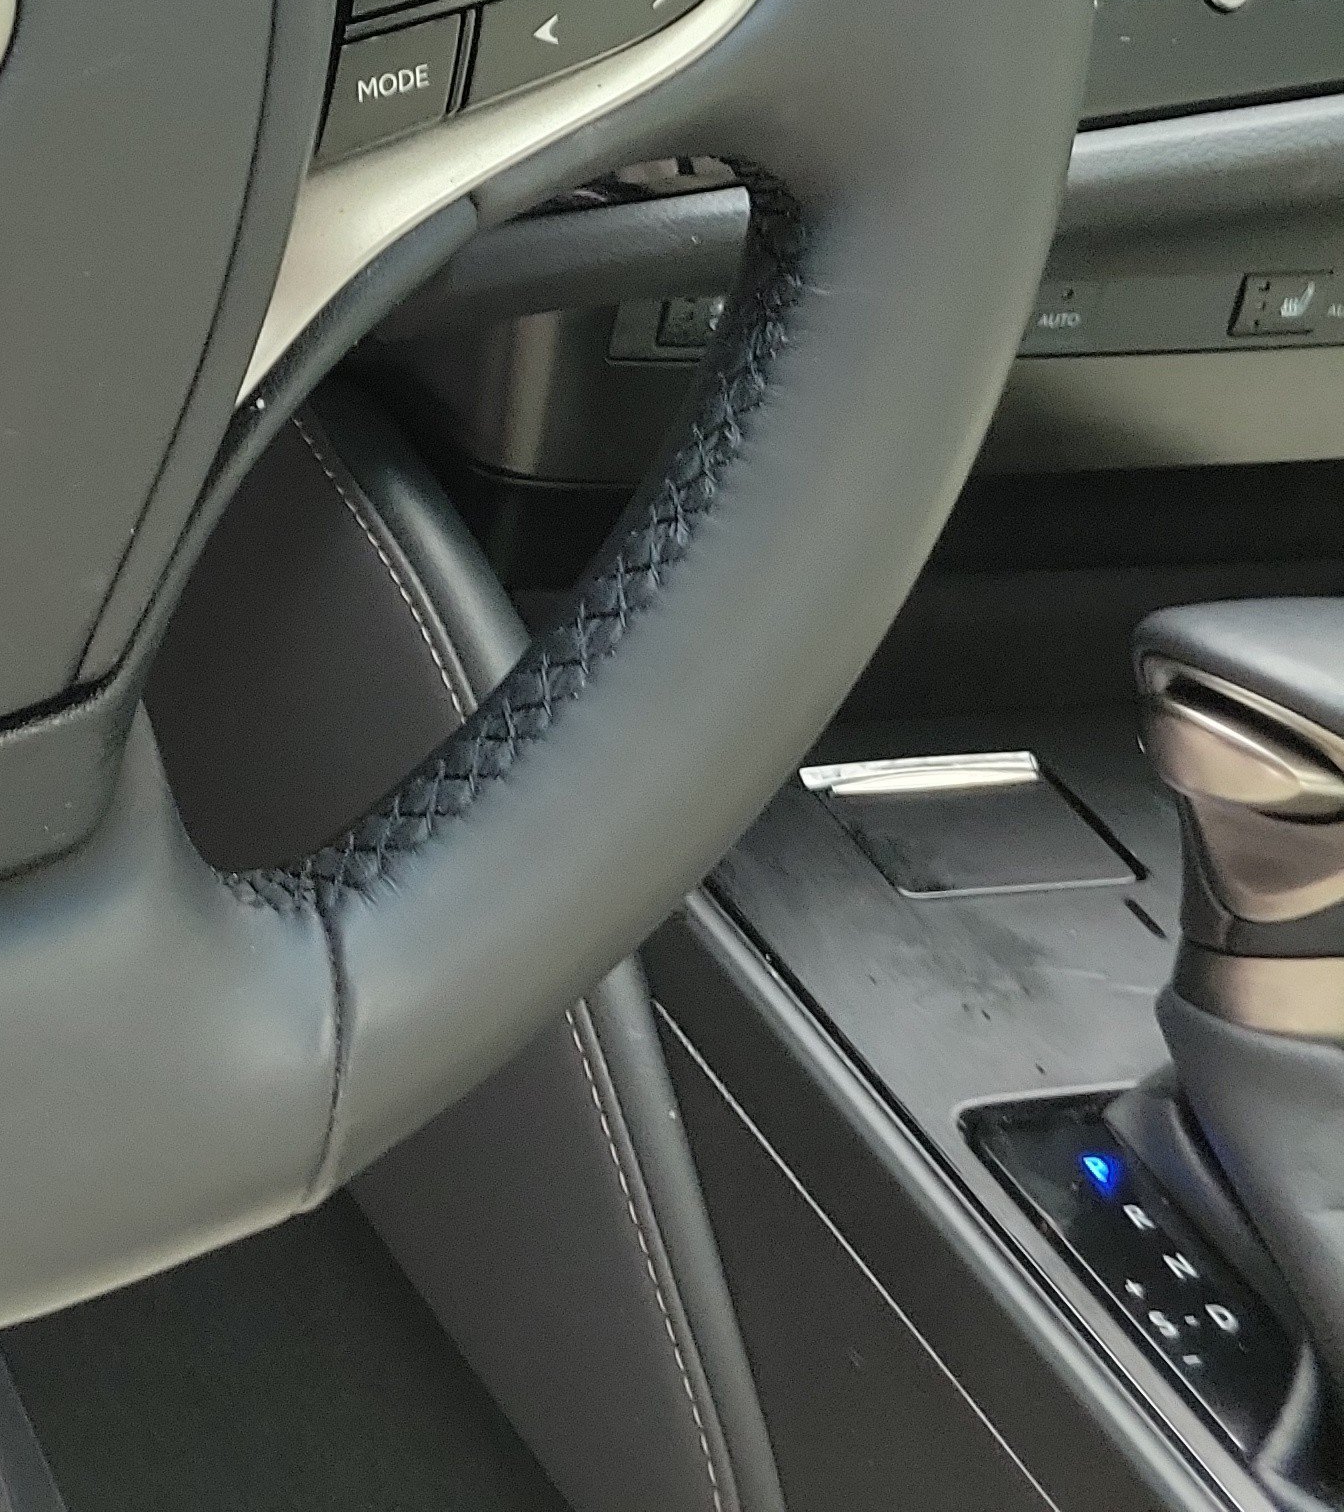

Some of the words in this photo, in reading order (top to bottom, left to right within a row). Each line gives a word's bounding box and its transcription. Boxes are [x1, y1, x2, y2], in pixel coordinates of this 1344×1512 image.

[356, 63, 431, 104] MODE
[1037, 311, 1083, 329] AUTO
[1123, 1203, 1158, 1231] R
[1161, 1252, 1201, 1280] N
[1204, 1303, 1239, 1334] D
